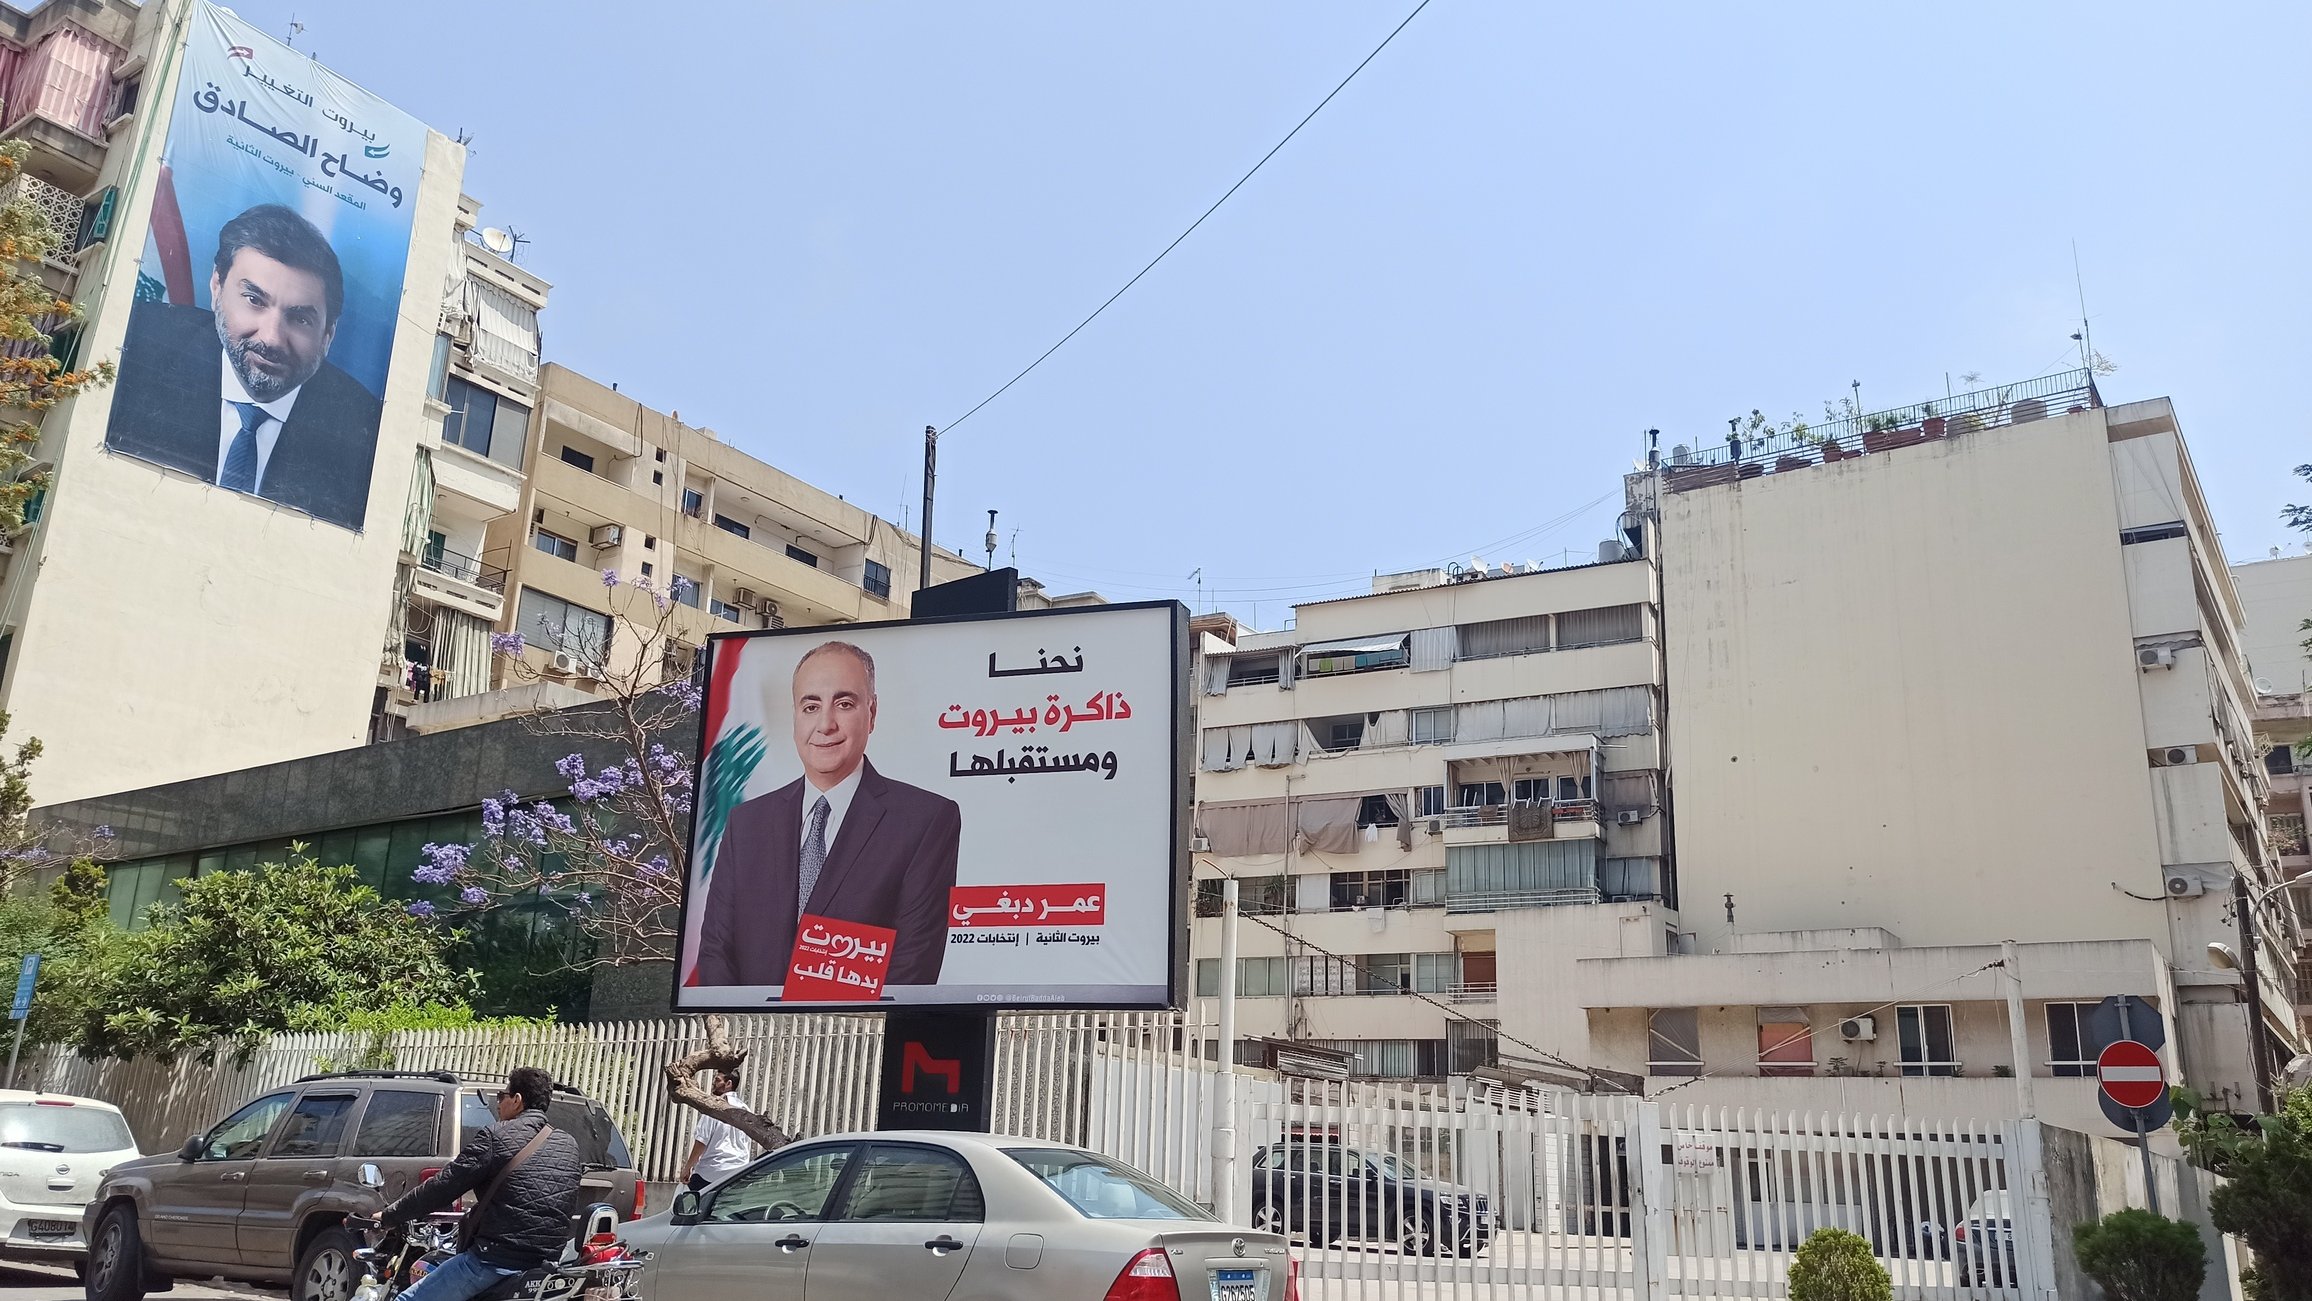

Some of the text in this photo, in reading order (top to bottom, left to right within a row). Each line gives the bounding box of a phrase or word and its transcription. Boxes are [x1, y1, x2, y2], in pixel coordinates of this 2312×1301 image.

[243, 65, 376, 143] بيروت التغيير
[193, 82, 403, 208] وضاح الصادق
[226, 135, 262, 159] الثانية
[262, 154, 295, 177] بيروت
[302, 176, 333, 194] السني
[334, 191, 366, 211] المقعد
[988, 646, 1084, 678] نحنا
[938, 690, 1132, 737] ذاكرة بيروت
[949, 745, 1118, 784] ومستقبلها
[952, 890, 1101, 926] عمر دبغي
[802, 924, 887, 964] بيروت
[950, 933, 975, 944] 2022
[977, 933, 1020, 947] إنتخابات
[1036, 930, 1066, 946] الثانية
[1067, 932, 1100, 946] بيروت
[793, 960, 878, 994] بدها قلب
